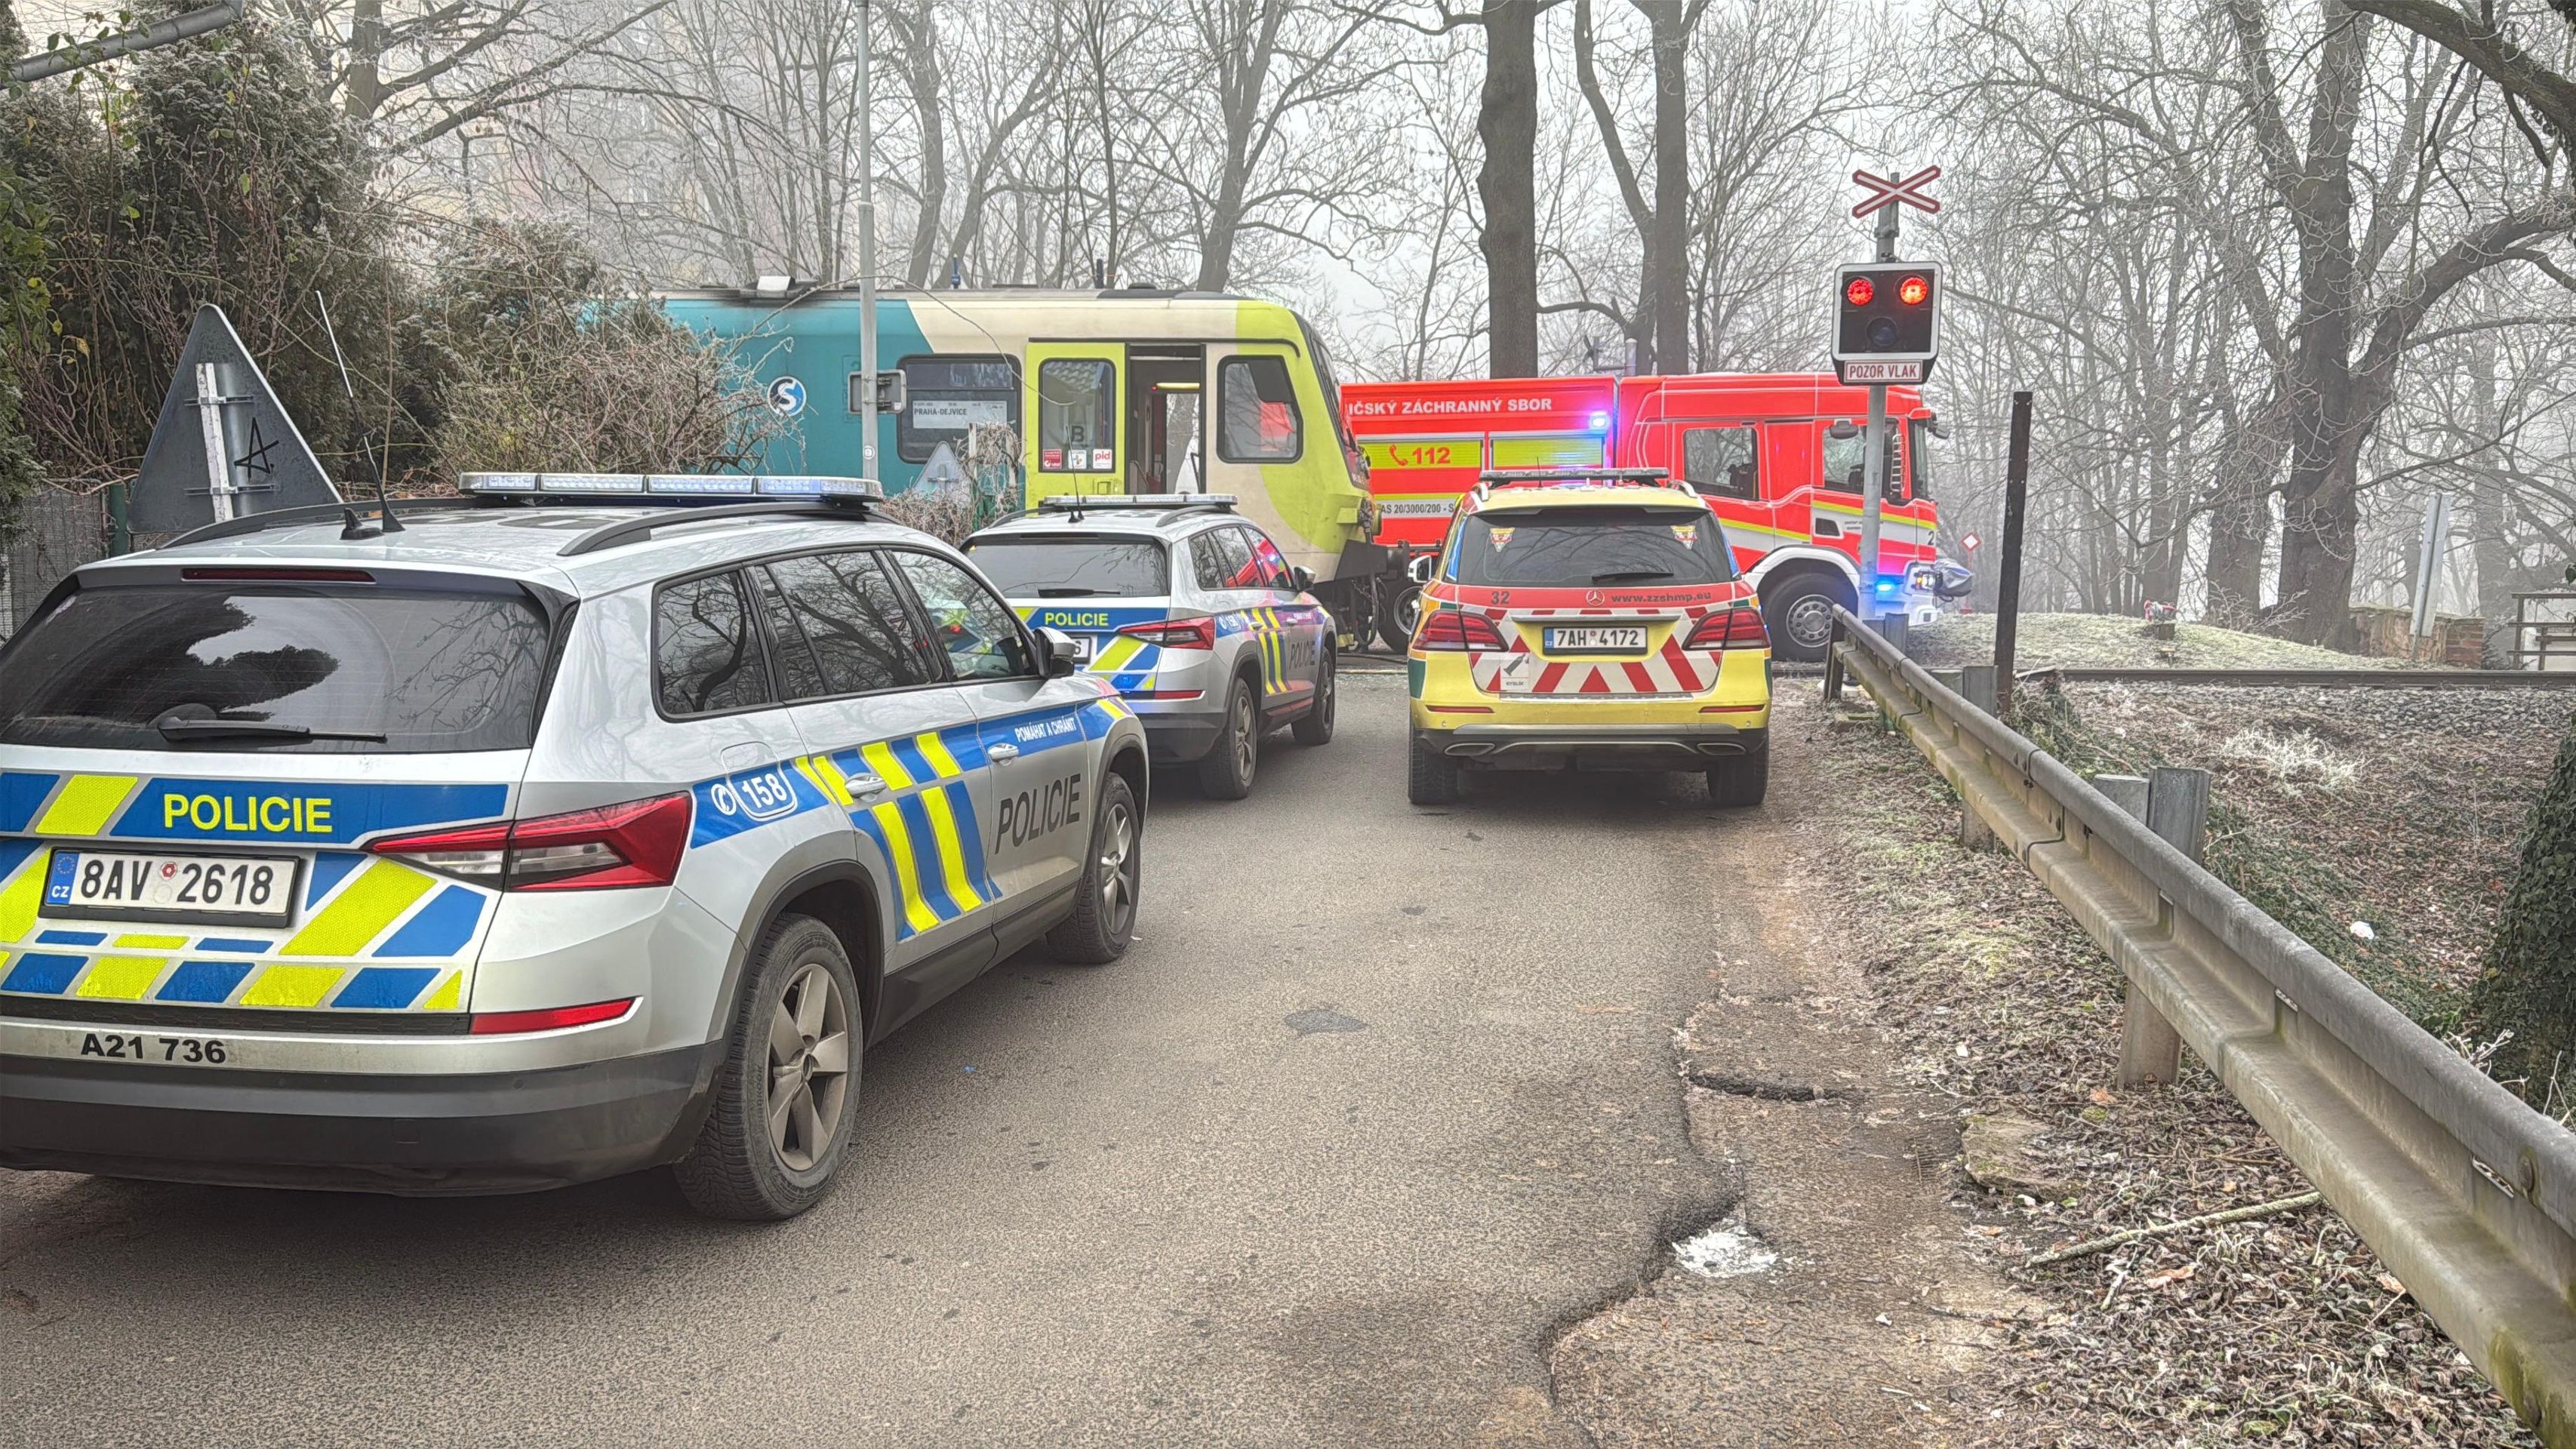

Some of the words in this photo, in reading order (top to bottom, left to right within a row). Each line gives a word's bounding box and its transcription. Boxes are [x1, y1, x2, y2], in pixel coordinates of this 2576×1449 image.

[1849, 365, 1884, 378] POZOR
[1888, 365, 1916, 378] VLAK
[913, 408, 968, 416] PRAHA-DEJVICE
[1348, 399, 1397, 415] IČSKÝ
[1402, 397, 1503, 414] ZÁCHRANNÝ
[1507, 398, 1552, 411] SBOR
[1094, 450, 1111, 462] pid
[1411, 446, 1451, 465] 112
[1393, 503, 1442, 514] 20/3000/200
[1927, 530, 1935, 546] 2
[1490, 591, 1510, 605] 32
[1611, 592, 1711, 602] www.zzshmp.eu
[1044, 612, 1109, 626] POLICIE
[1557, 629, 1587, 646] 7AH
[1599, 629, 1639, 646] 4172
[1014, 721, 1048, 743] POMÁHAT
[1046, 723, 1053, 737] A
[1051, 715, 1077, 735] CHRÁNIT
[741, 773, 787, 809] 158
[164, 793, 333, 832] POLICIE
[995, 773, 1081, 855] POLICIE
[80, 859, 153, 900] 8AV
[177, 863, 274, 906] 2618
[51, 885, 69, 898] CZ
[81, 1033, 143, 1060] A21
[158, 1038, 226, 1064] 736
